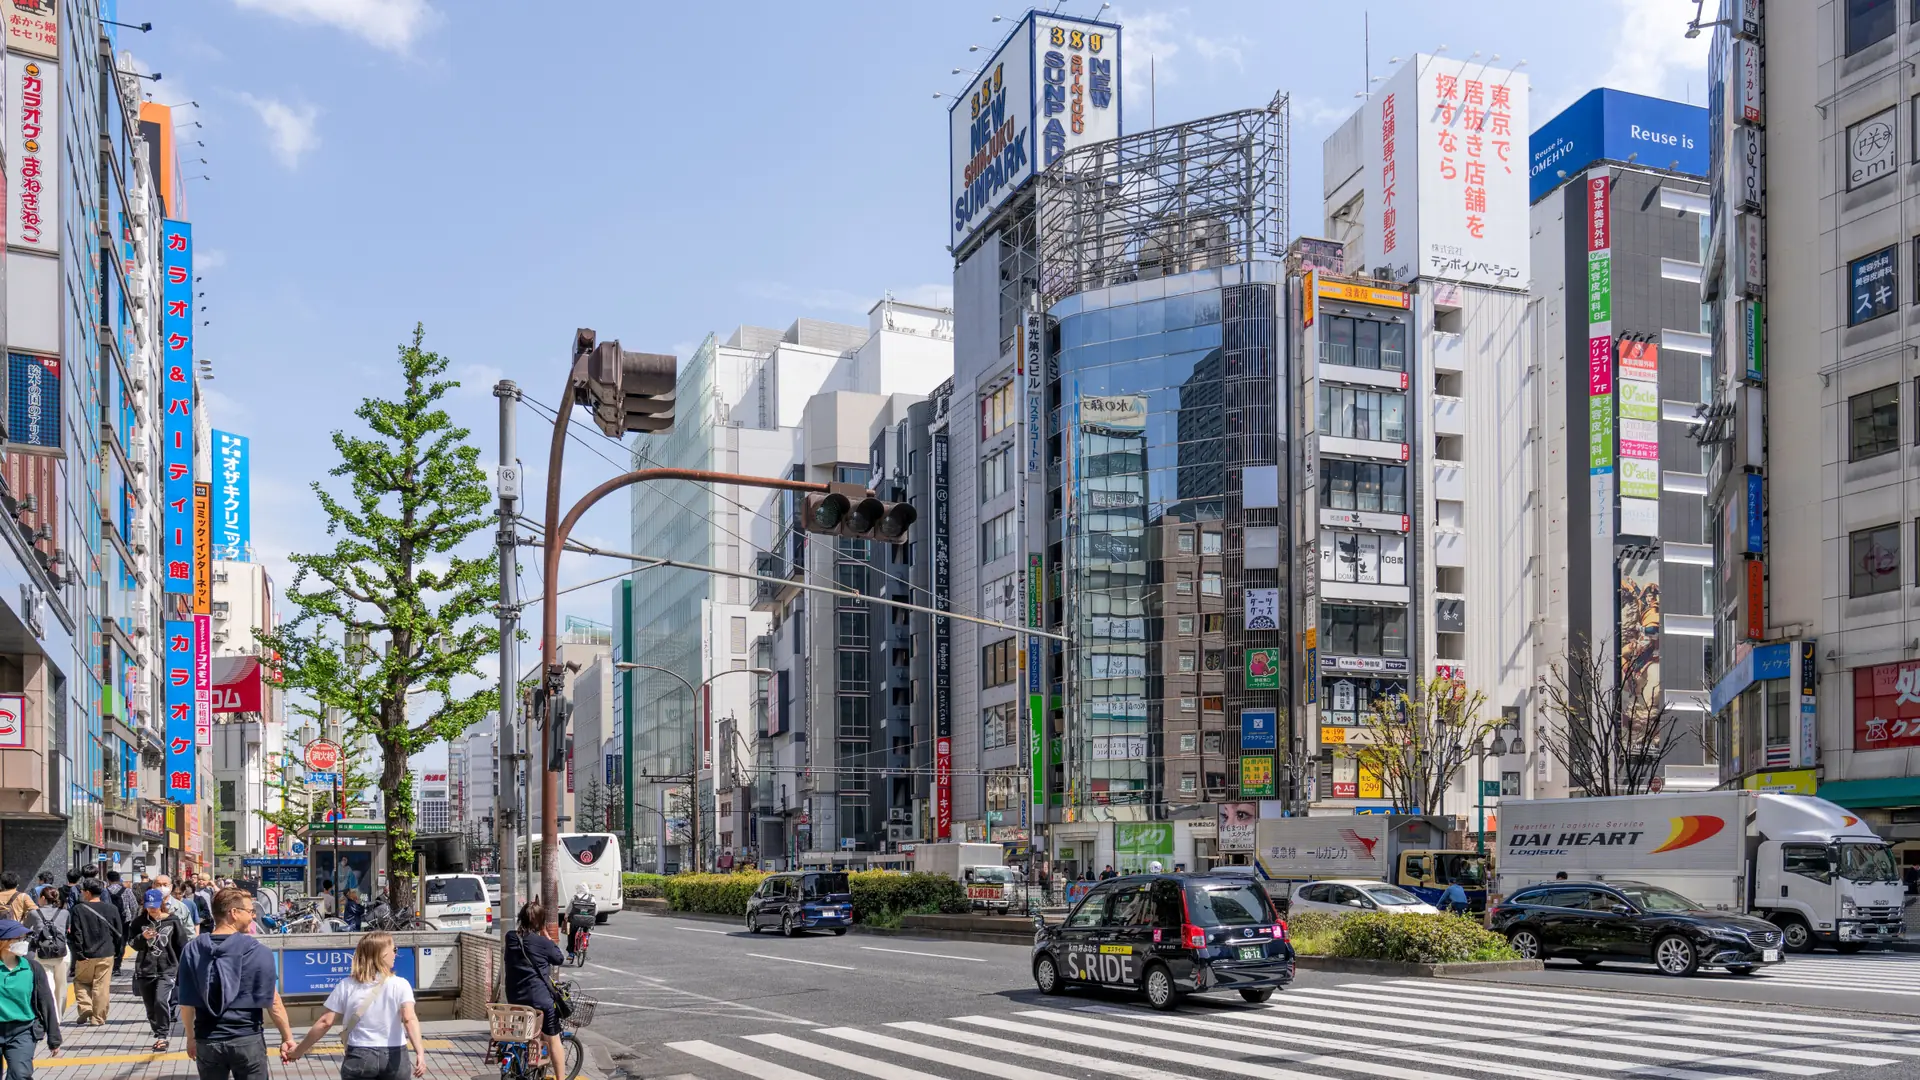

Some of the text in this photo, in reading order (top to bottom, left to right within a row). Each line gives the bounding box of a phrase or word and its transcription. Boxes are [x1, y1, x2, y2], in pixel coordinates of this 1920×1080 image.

[9, 14, 57, 34] 赤から鍋
[10, 27, 57, 46] セセリ焼
[1051, 26, 1104, 54] 389
[970, 62, 1004, 121] 389
[1071, 54, 1085, 135] SHINJUKU
[1089, 57, 1112, 109] NEW
[970, 86, 1008, 160] NEW
[1436, 72, 1459, 181] 探すなら
[1490, 83, 1512, 175] 東京で、
[1630, 124, 1694, 150] Reuse is
[21, 76, 43, 244] カラオケ まねきねこ
[964, 114, 1016, 190] SHINJUKU
[1463, 79, 1487, 240] 居抜き店舗を
[1535, 137, 1564, 161] Reuse is
[1747, 130, 1758, 202] MOUTON
[955, 126, 1029, 233] SUNPARK
[1382, 92, 1396, 256] 店舗専門不動産
[1852, 151, 1894, 183] emi
[1593, 190, 1605, 248] 東京美容外科
[1430, 243, 1463, 256] 株式会社
[1430, 255, 1520, 279] テンポイノベーション
[1858, 255, 1889, 276] 美容外科
[1591, 262, 1601, 311] 美容皮膚科
[1601, 259, 1609, 294] オラクル
[1855, 265, 1893, 288] 美容皮膚科
[1593, 312, 1607, 321] 8F
[1028, 316, 1041, 389] 新光第2ビル
[1592, 339, 1600, 383] クリニック
[1601, 338, 1609, 373] フィラー
[1593, 383, 1607, 393] 7F
[1030, 397, 1040, 458] パステルコート
[1591, 398, 1602, 455] 美容皮膚科
[1603, 395, 1611, 435] オラクル
[1595, 456, 1608, 466] 6F
[222, 457, 242, 560] オザキクリニック
[196, 500, 208, 606] コミック・インターネット
[1250, 597, 1273, 607] ダーツ
[1250, 606, 1275, 616] グッズ
[196, 653, 208, 687] コスモス
[170, 634, 192, 790] カラオケ館
[312, 751, 335, 761] 消火栓
[1119, 829, 1167, 847] レイク
[1509, 831, 1644, 847] DAI HEART
[1561, 822, 1600, 830] Logistic
[1605, 820, 1645, 829] Service
[1509, 848, 1569, 857] Logistic
